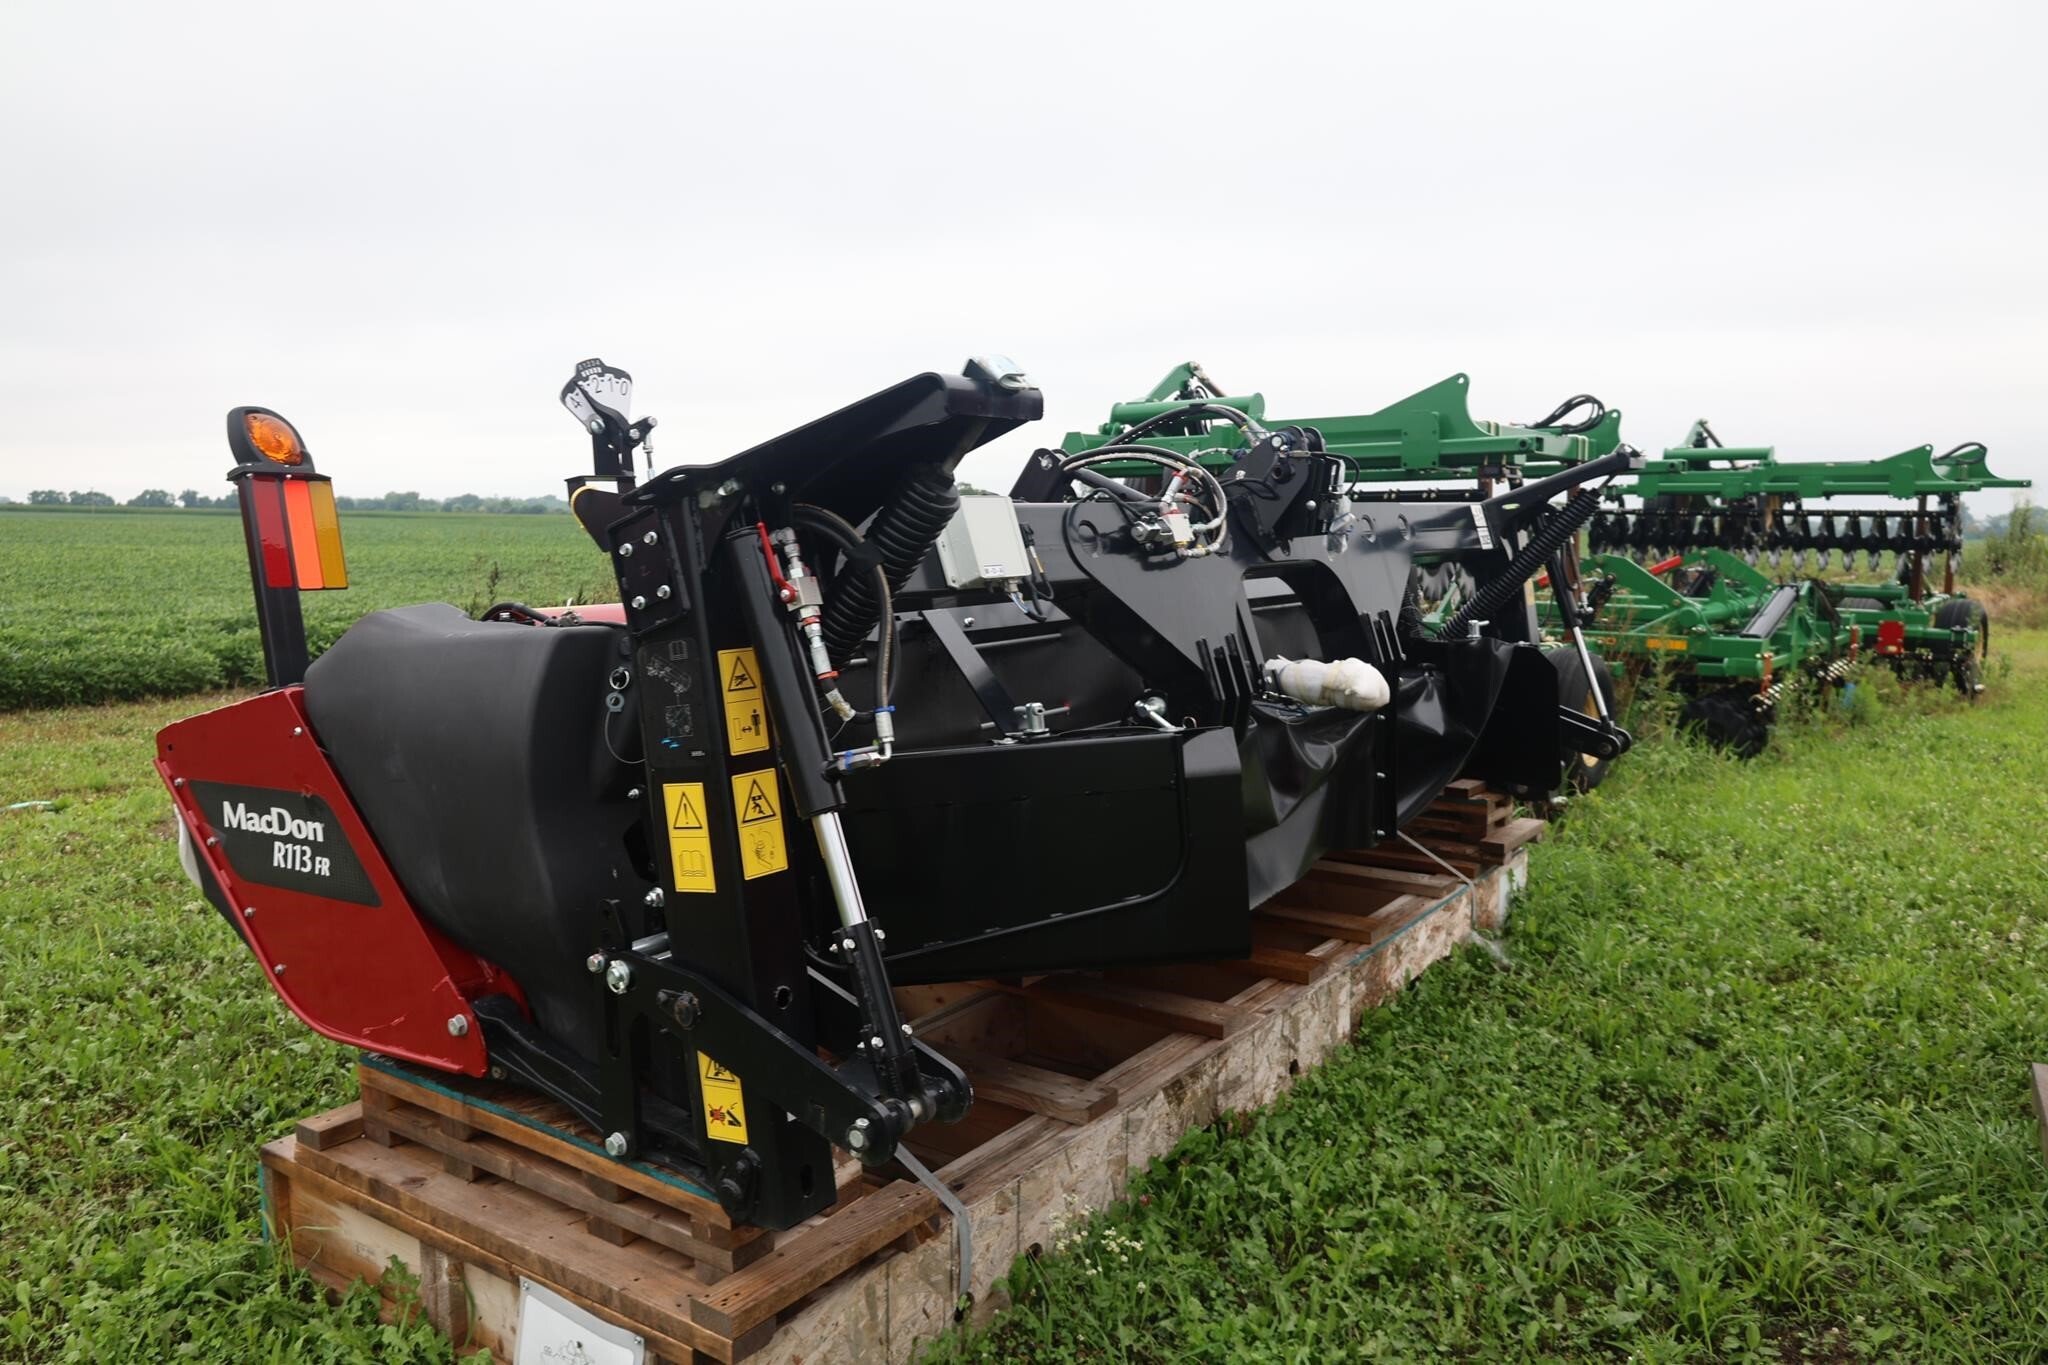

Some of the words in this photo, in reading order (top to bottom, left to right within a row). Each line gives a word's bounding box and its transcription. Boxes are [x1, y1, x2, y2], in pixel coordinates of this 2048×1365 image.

[591, 377, 602, 393] 2
[608, 376, 614, 392] 1
[620, 380, 629, 396] 0
[223, 801, 324, 842] MacDon
[273, 841, 312, 873] R113
[315, 856, 330, 876] FR
